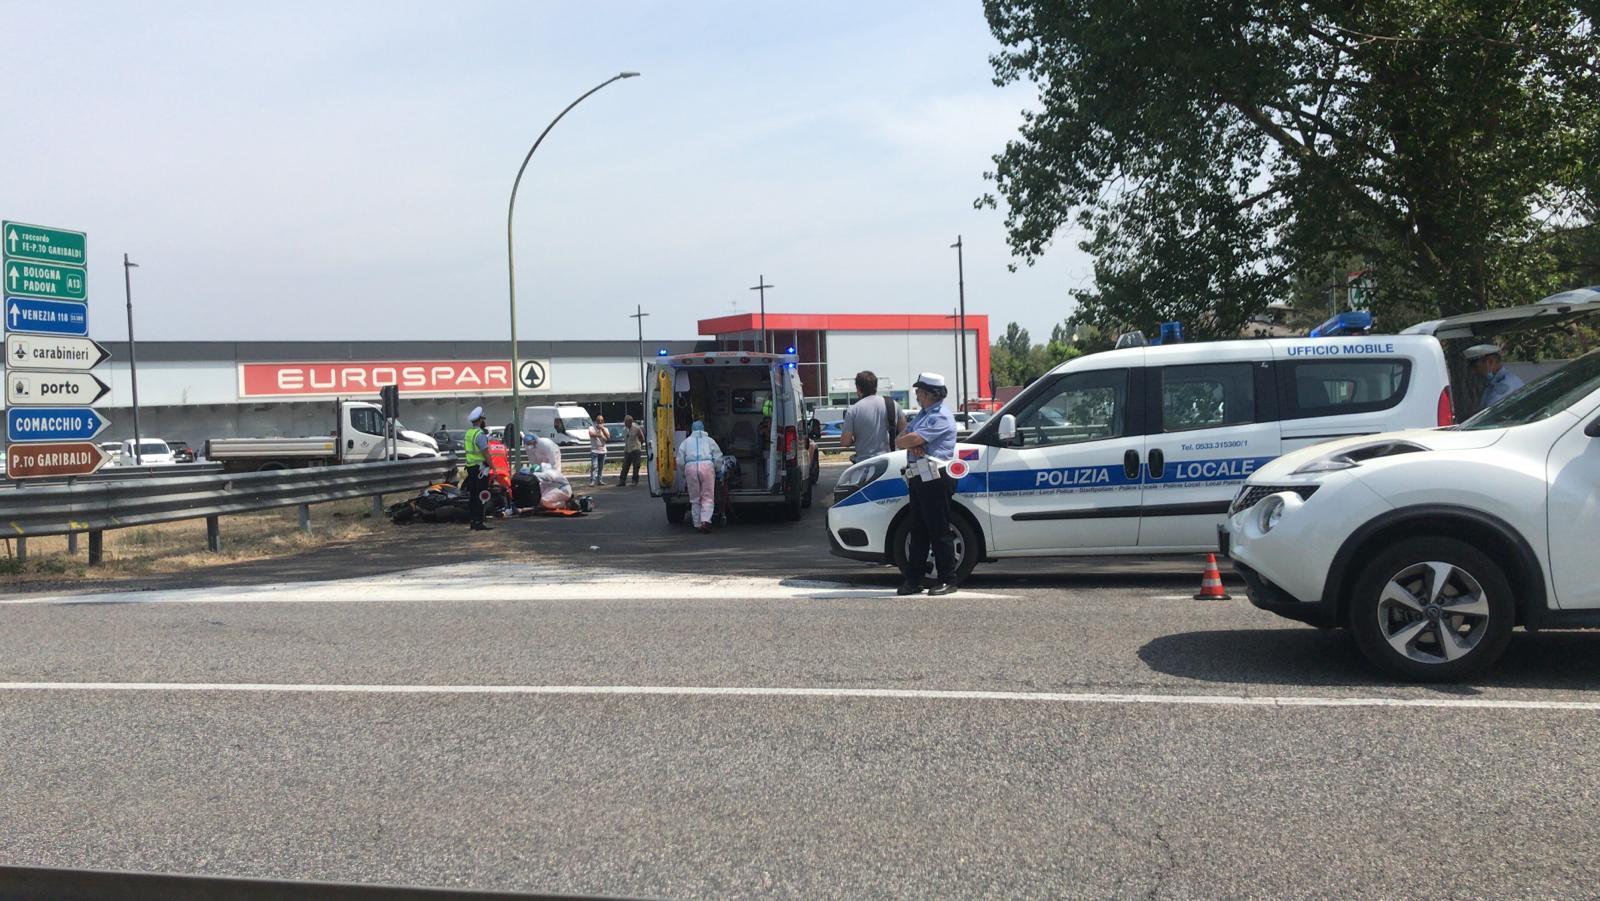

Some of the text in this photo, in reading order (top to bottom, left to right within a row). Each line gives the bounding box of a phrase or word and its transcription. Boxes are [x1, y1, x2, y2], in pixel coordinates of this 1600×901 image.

[22, 233, 50, 243] raccordo
[48, 246, 82, 258] GARIBALDI
[23, 266, 61, 280] BOLOGNA
[23, 280, 56, 293] PADOVA
[67, 278, 81, 289] A13
[22, 309, 56, 322] VENEZIA
[57, 313, 69, 322] 118
[33, 346, 89, 360] carabinieri
[1287, 344, 1394, 356] UFFICIO MOBILE
[277, 365, 508, 389] EUROSPAR
[41, 381, 80, 395] porto
[15, 417, 93, 432] COMACCHIO 5
[37, 452, 91, 467] GARIBALDI
[1175, 460, 1255, 479] LOCALE
[1035, 468, 1110, 486] POLIZIA
